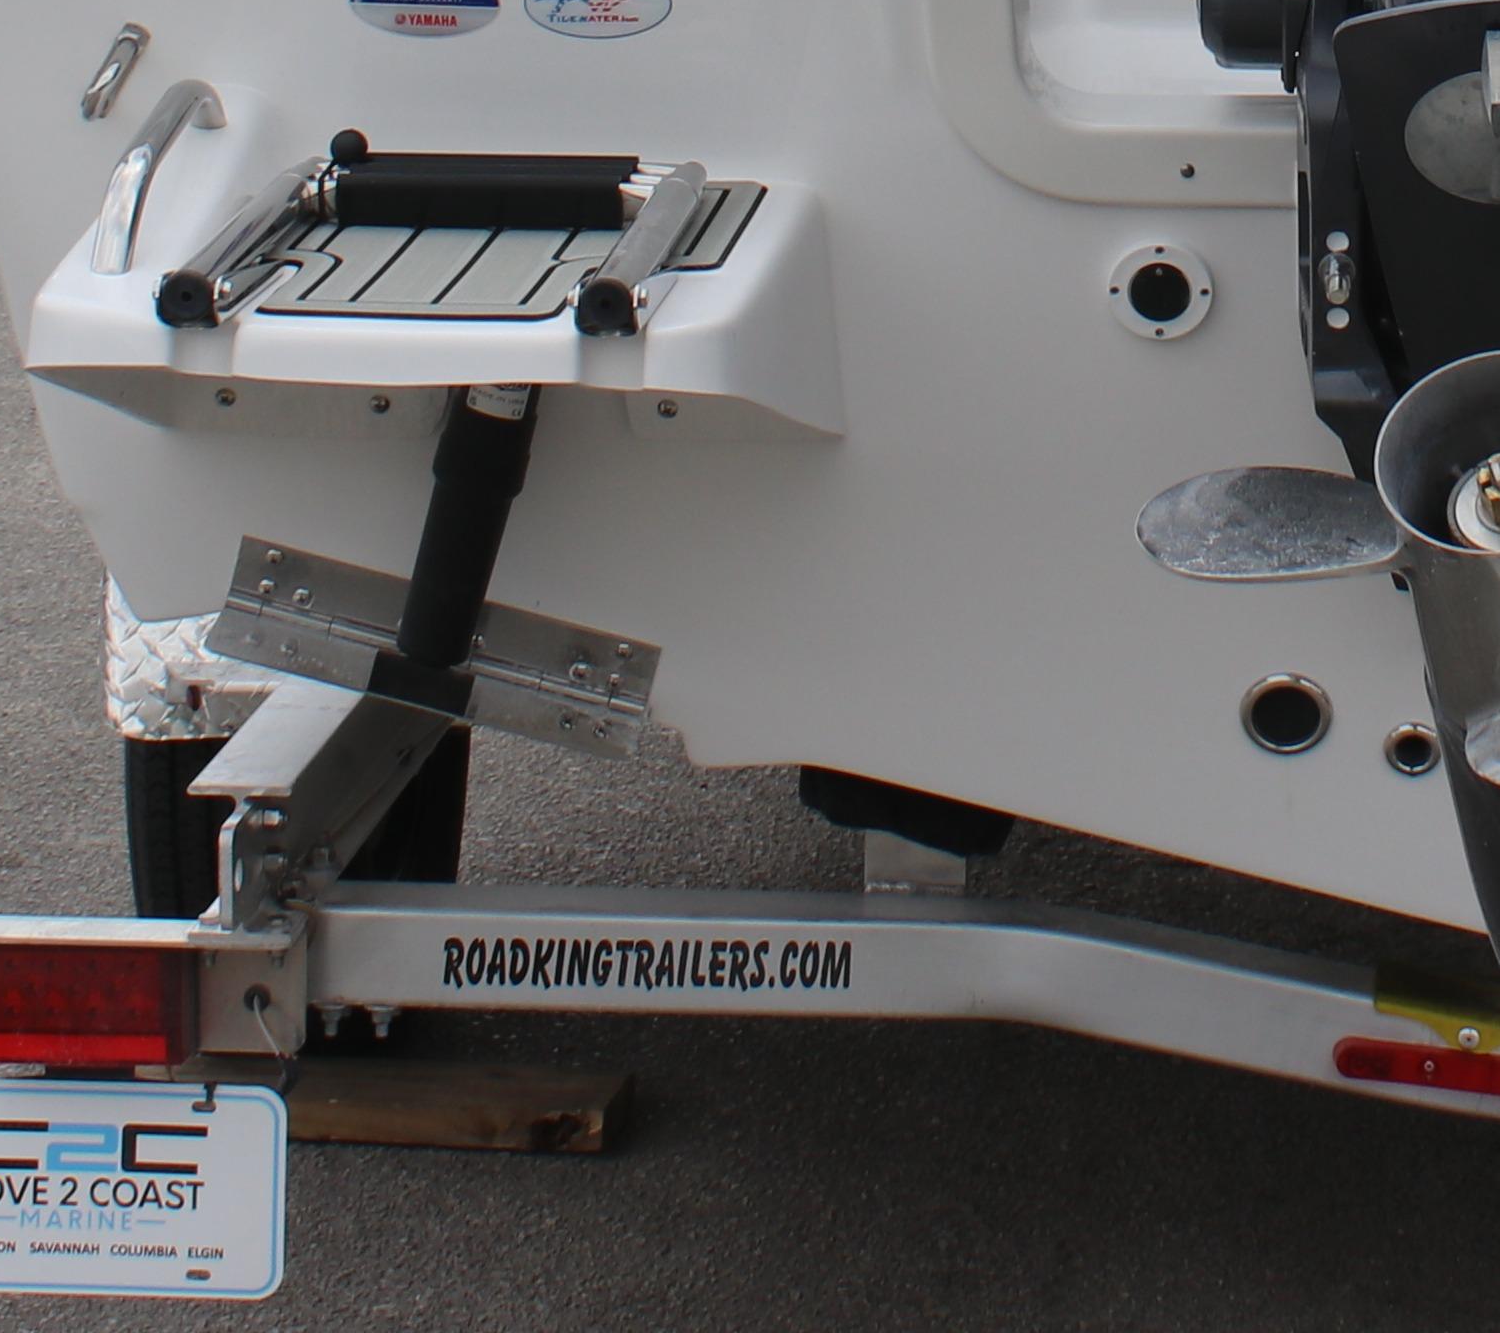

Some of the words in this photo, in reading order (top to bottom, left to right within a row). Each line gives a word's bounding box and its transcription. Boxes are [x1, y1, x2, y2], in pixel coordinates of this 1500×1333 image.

[406, 13, 458, 27] YAMAHA
[443, 936, 852, 991] ROADKINGTRAILERS.COM
[59, 1177, 79, 1206] 2
[89, 1178, 205, 1210] COAST
[19, 1208, 133, 1231] MARINE
[30, 1242, 100, 1255] SAVANNAH
[110, 1244, 178, 1257] COLUMBIA
[187, 1246, 224, 1259] ELGIN
